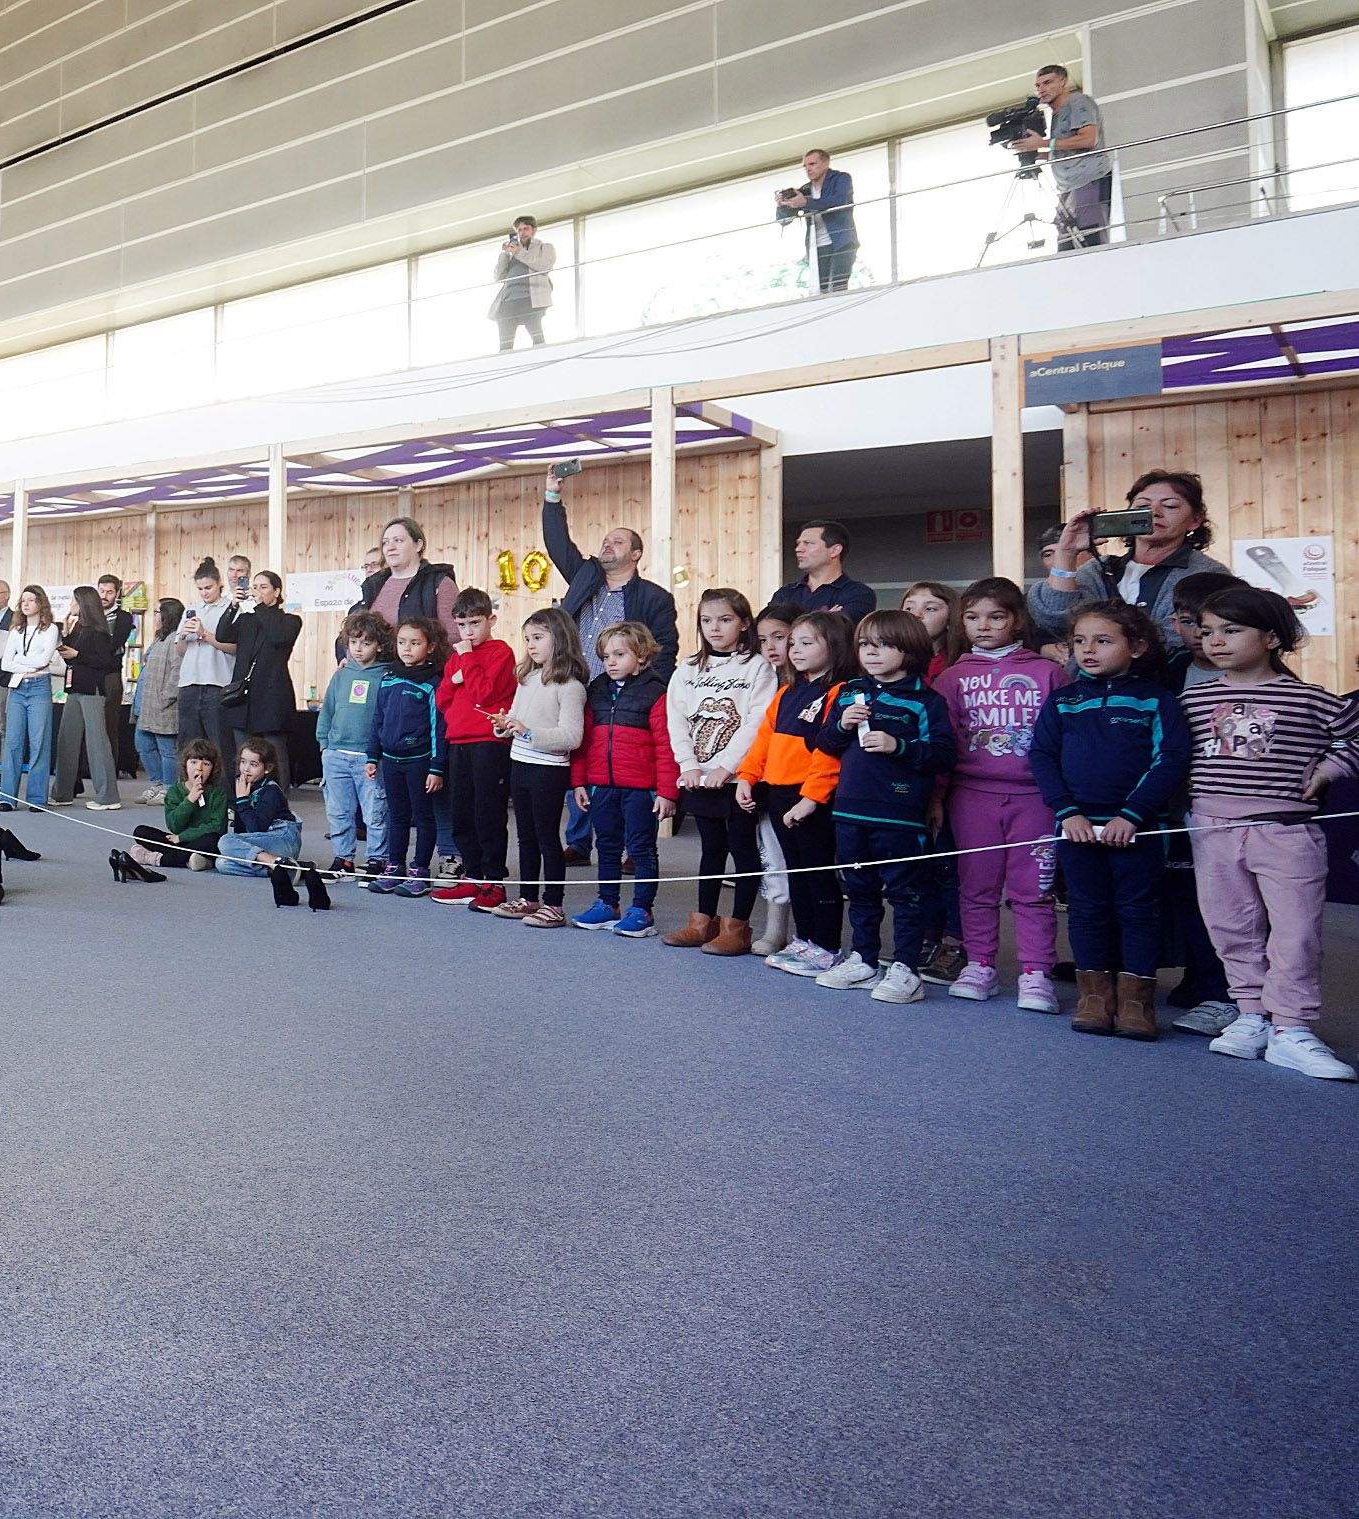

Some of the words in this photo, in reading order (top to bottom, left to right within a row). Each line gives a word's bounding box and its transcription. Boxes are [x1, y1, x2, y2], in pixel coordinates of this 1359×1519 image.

[1082, 359, 1126, 371] Folque
[497, 550, 550, 594] 10
[959, 673, 992, 692] YOU
[963, 689, 1010, 709] MAKE
[1014, 689, 1042, 707] ME
